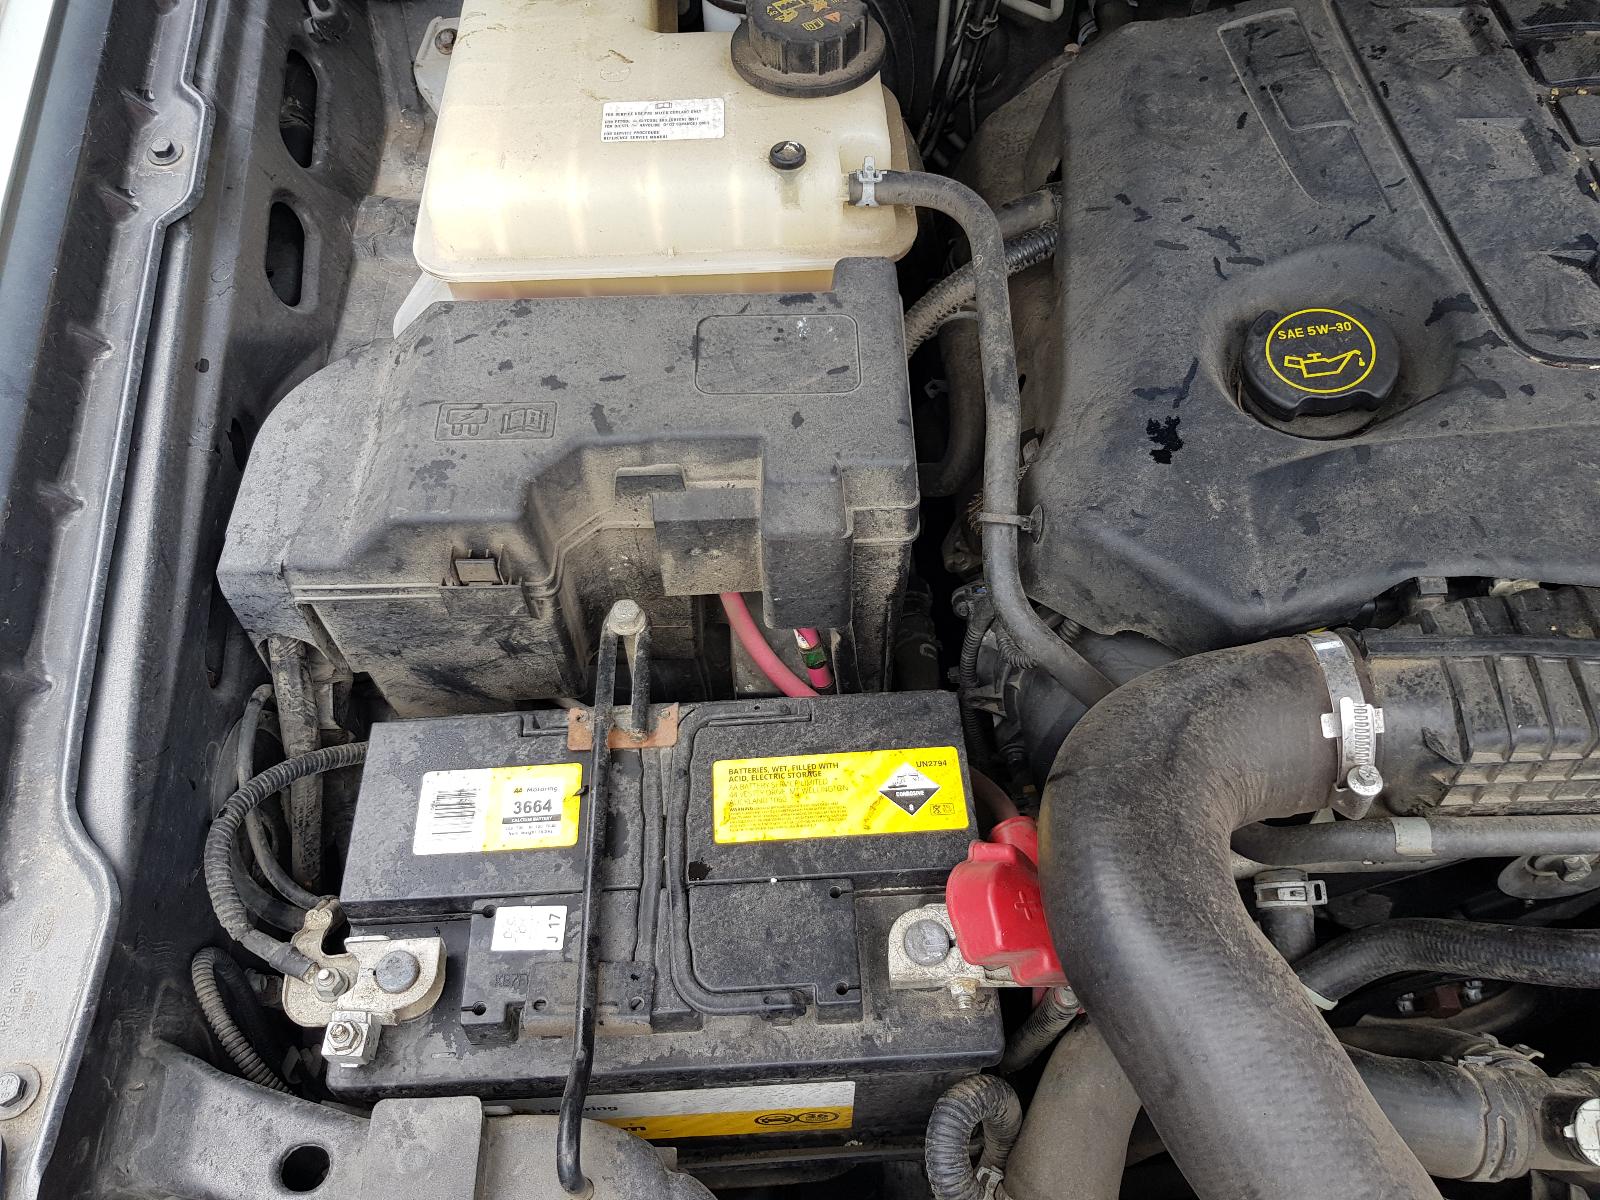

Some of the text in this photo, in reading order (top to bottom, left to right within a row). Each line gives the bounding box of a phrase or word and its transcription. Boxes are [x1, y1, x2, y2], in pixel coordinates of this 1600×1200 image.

[1278, 321, 1352, 340] SAE 5W-30
[728, 766, 770, 775] BATTERIES,
[772, 765, 790, 773] WET,
[791, 763, 817, 772] FILLED
[915, 760, 947, 768] UN2794
[751, 772, 786, 781] ELECTRIC
[787, 770, 822, 779] STORAGE
[513, 799, 552, 814] 3664
